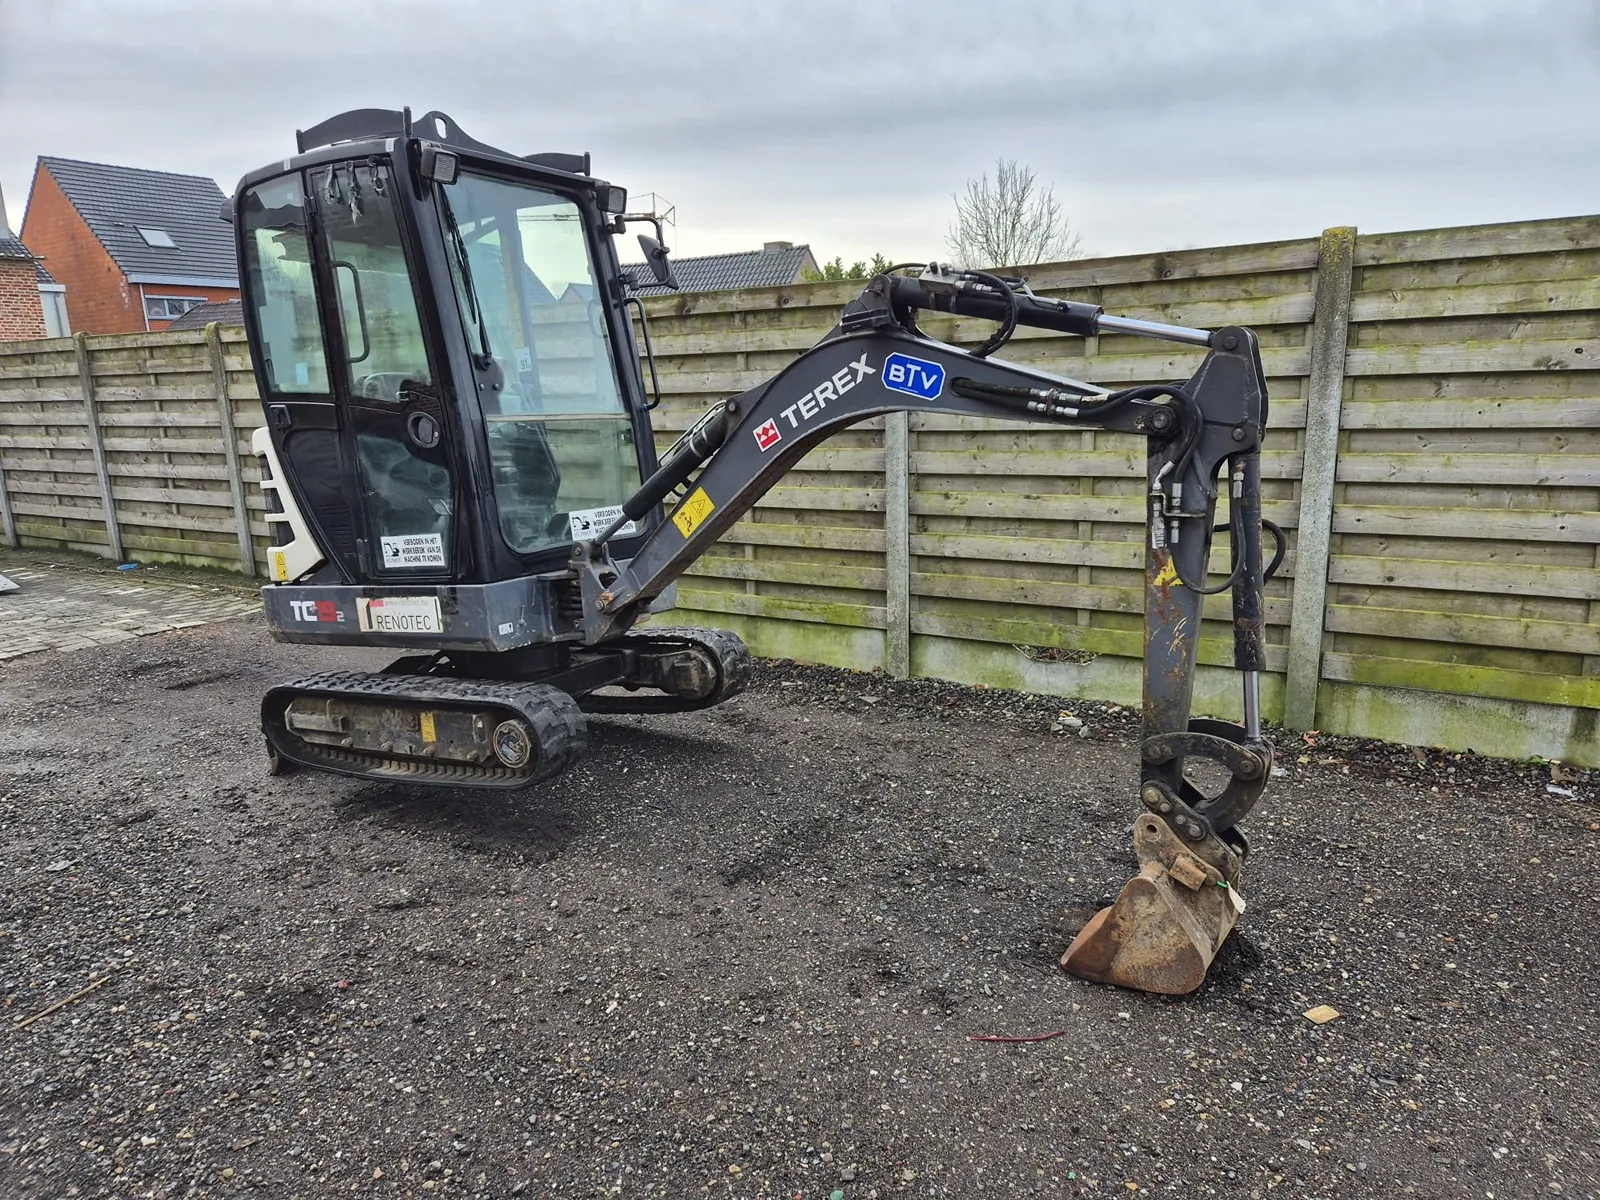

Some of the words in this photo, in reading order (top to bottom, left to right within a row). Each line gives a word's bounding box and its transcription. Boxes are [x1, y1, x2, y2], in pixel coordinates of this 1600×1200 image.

[888, 363, 938, 390] BTV
[780, 352, 877, 429] TEREX
[593, 510, 617, 518] VERBODEN
[403, 538, 425, 546] VERBODEN
[404, 555, 423, 563] MACHINE
[377, 615, 432, 631] RENOTEC
